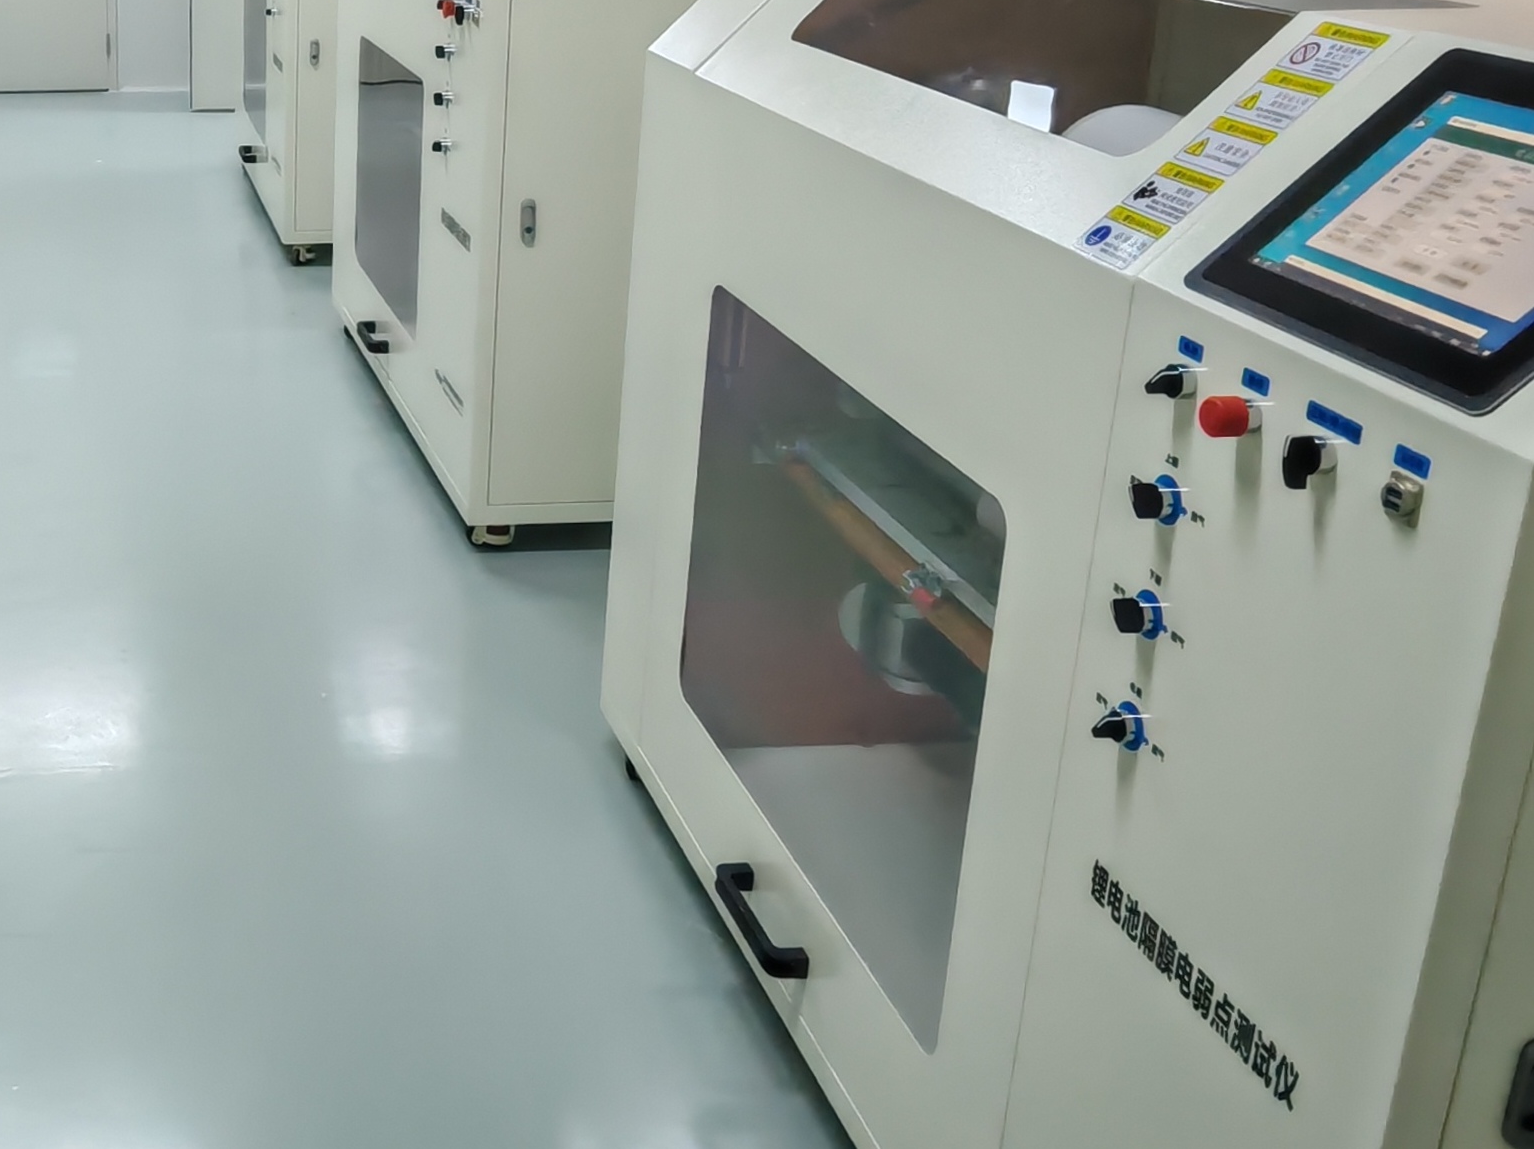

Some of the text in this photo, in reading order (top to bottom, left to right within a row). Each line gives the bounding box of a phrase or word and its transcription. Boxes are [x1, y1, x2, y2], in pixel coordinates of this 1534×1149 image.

[1091, 859, 1299, 1112] 锂电池隔膜电弱点测试仪
